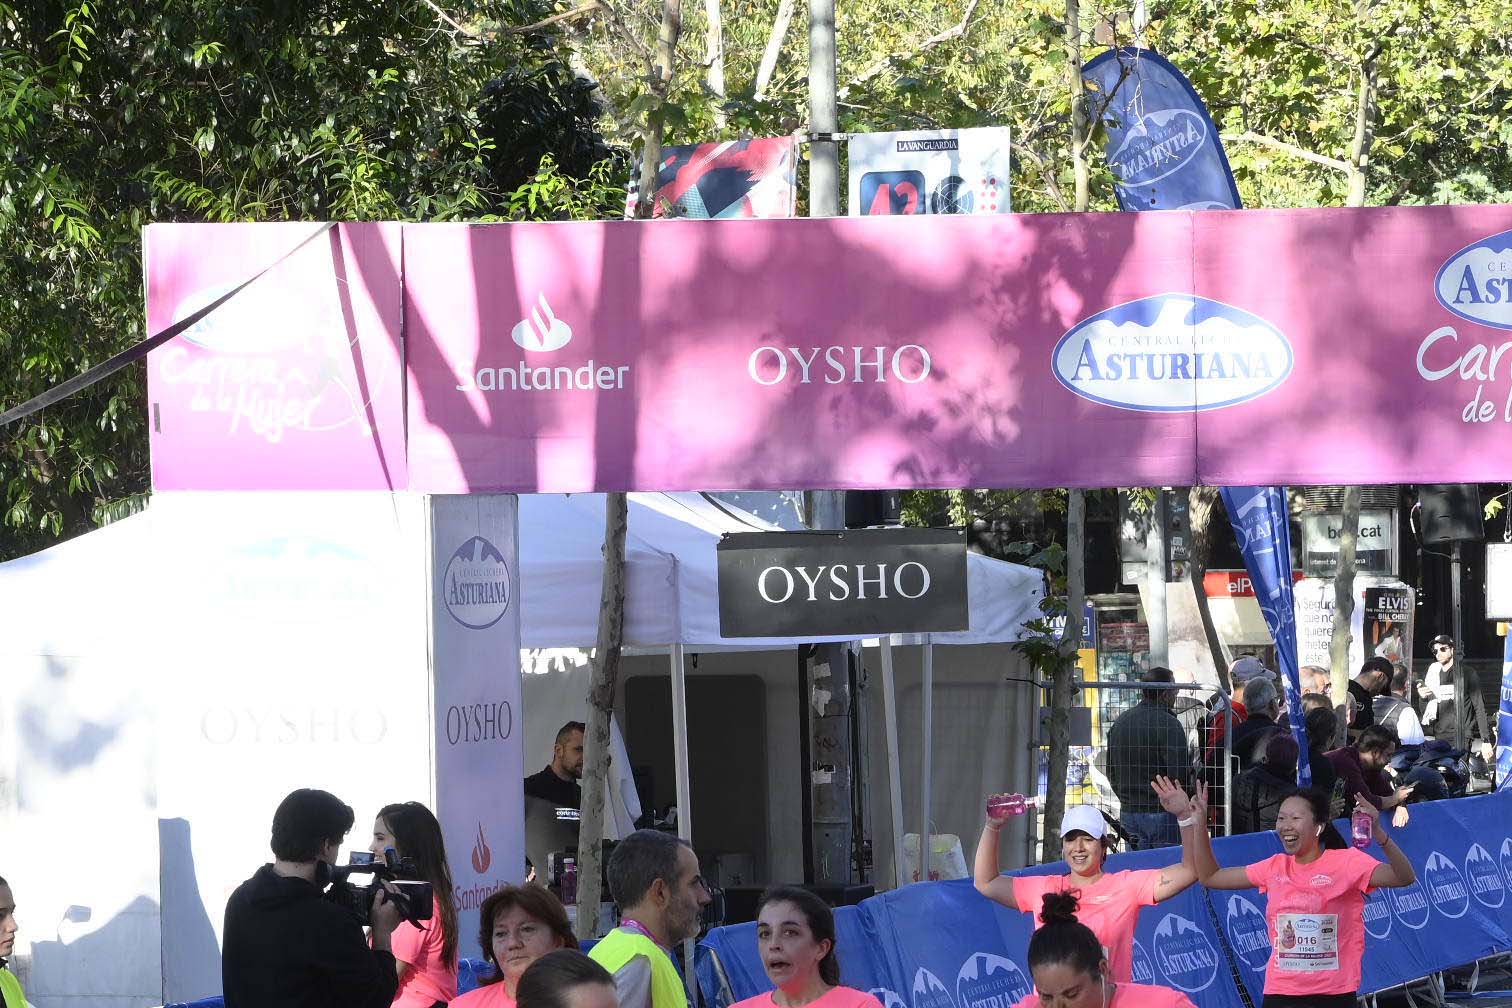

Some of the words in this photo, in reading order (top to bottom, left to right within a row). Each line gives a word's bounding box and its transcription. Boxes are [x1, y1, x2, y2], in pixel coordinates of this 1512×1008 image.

[456, 360, 629, 392] Santander
[748, 344, 931, 385] OYSHO
[1071, 337, 1274, 382] ASTURIANA
[1462, 386, 1497, 423] de
[450, 571, 507, 606] ASTURIANA
[758, 561, 931, 603] OYSHO
[1378, 597, 1409, 609] ELVIS
[446, 701, 512, 745] OYSHO
[1297, 936, 1317, 945] 016
